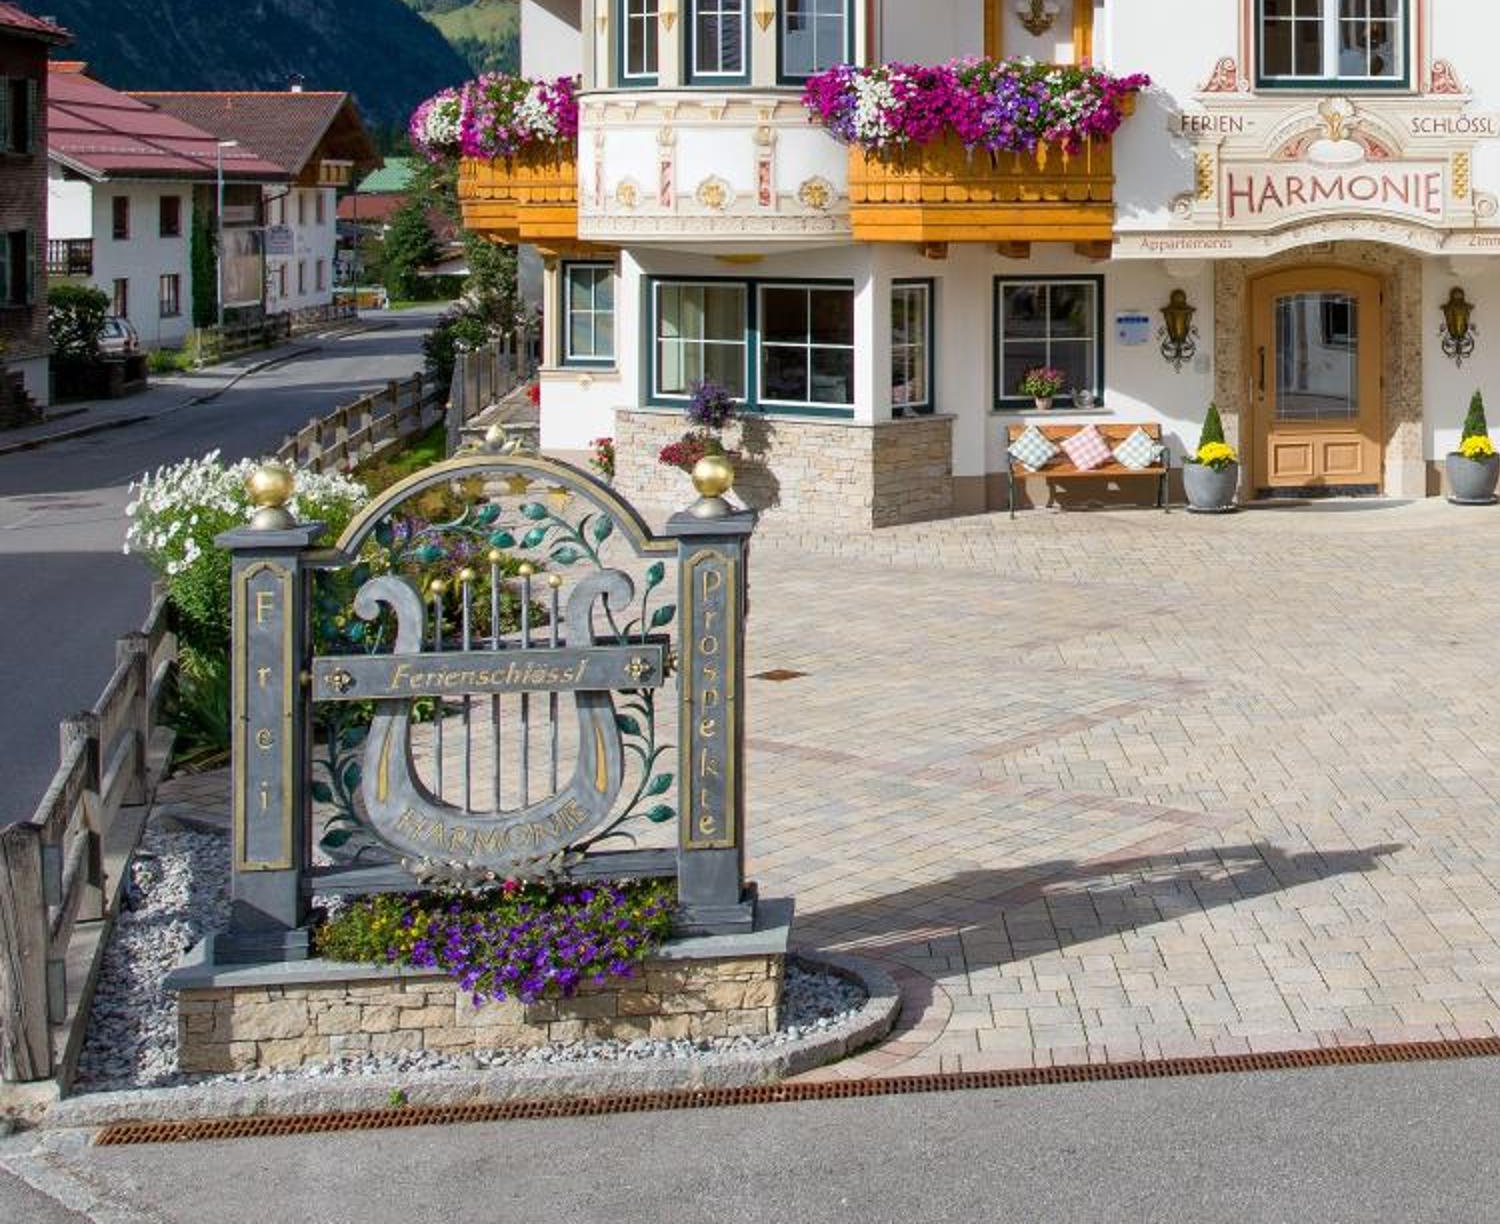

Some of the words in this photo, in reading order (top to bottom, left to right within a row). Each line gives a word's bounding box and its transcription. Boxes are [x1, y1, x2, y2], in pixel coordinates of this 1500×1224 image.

[1411, 114, 1496, 134] SCHLÖSSL
[1227, 172, 1440, 217] HARMONIE
[1140, 234, 1232, 252] Appartements
[390, 657, 589, 691] Ferienschlössl
[255, 591, 275, 812] Frei
[397, 796, 592, 857] HARMONIE
